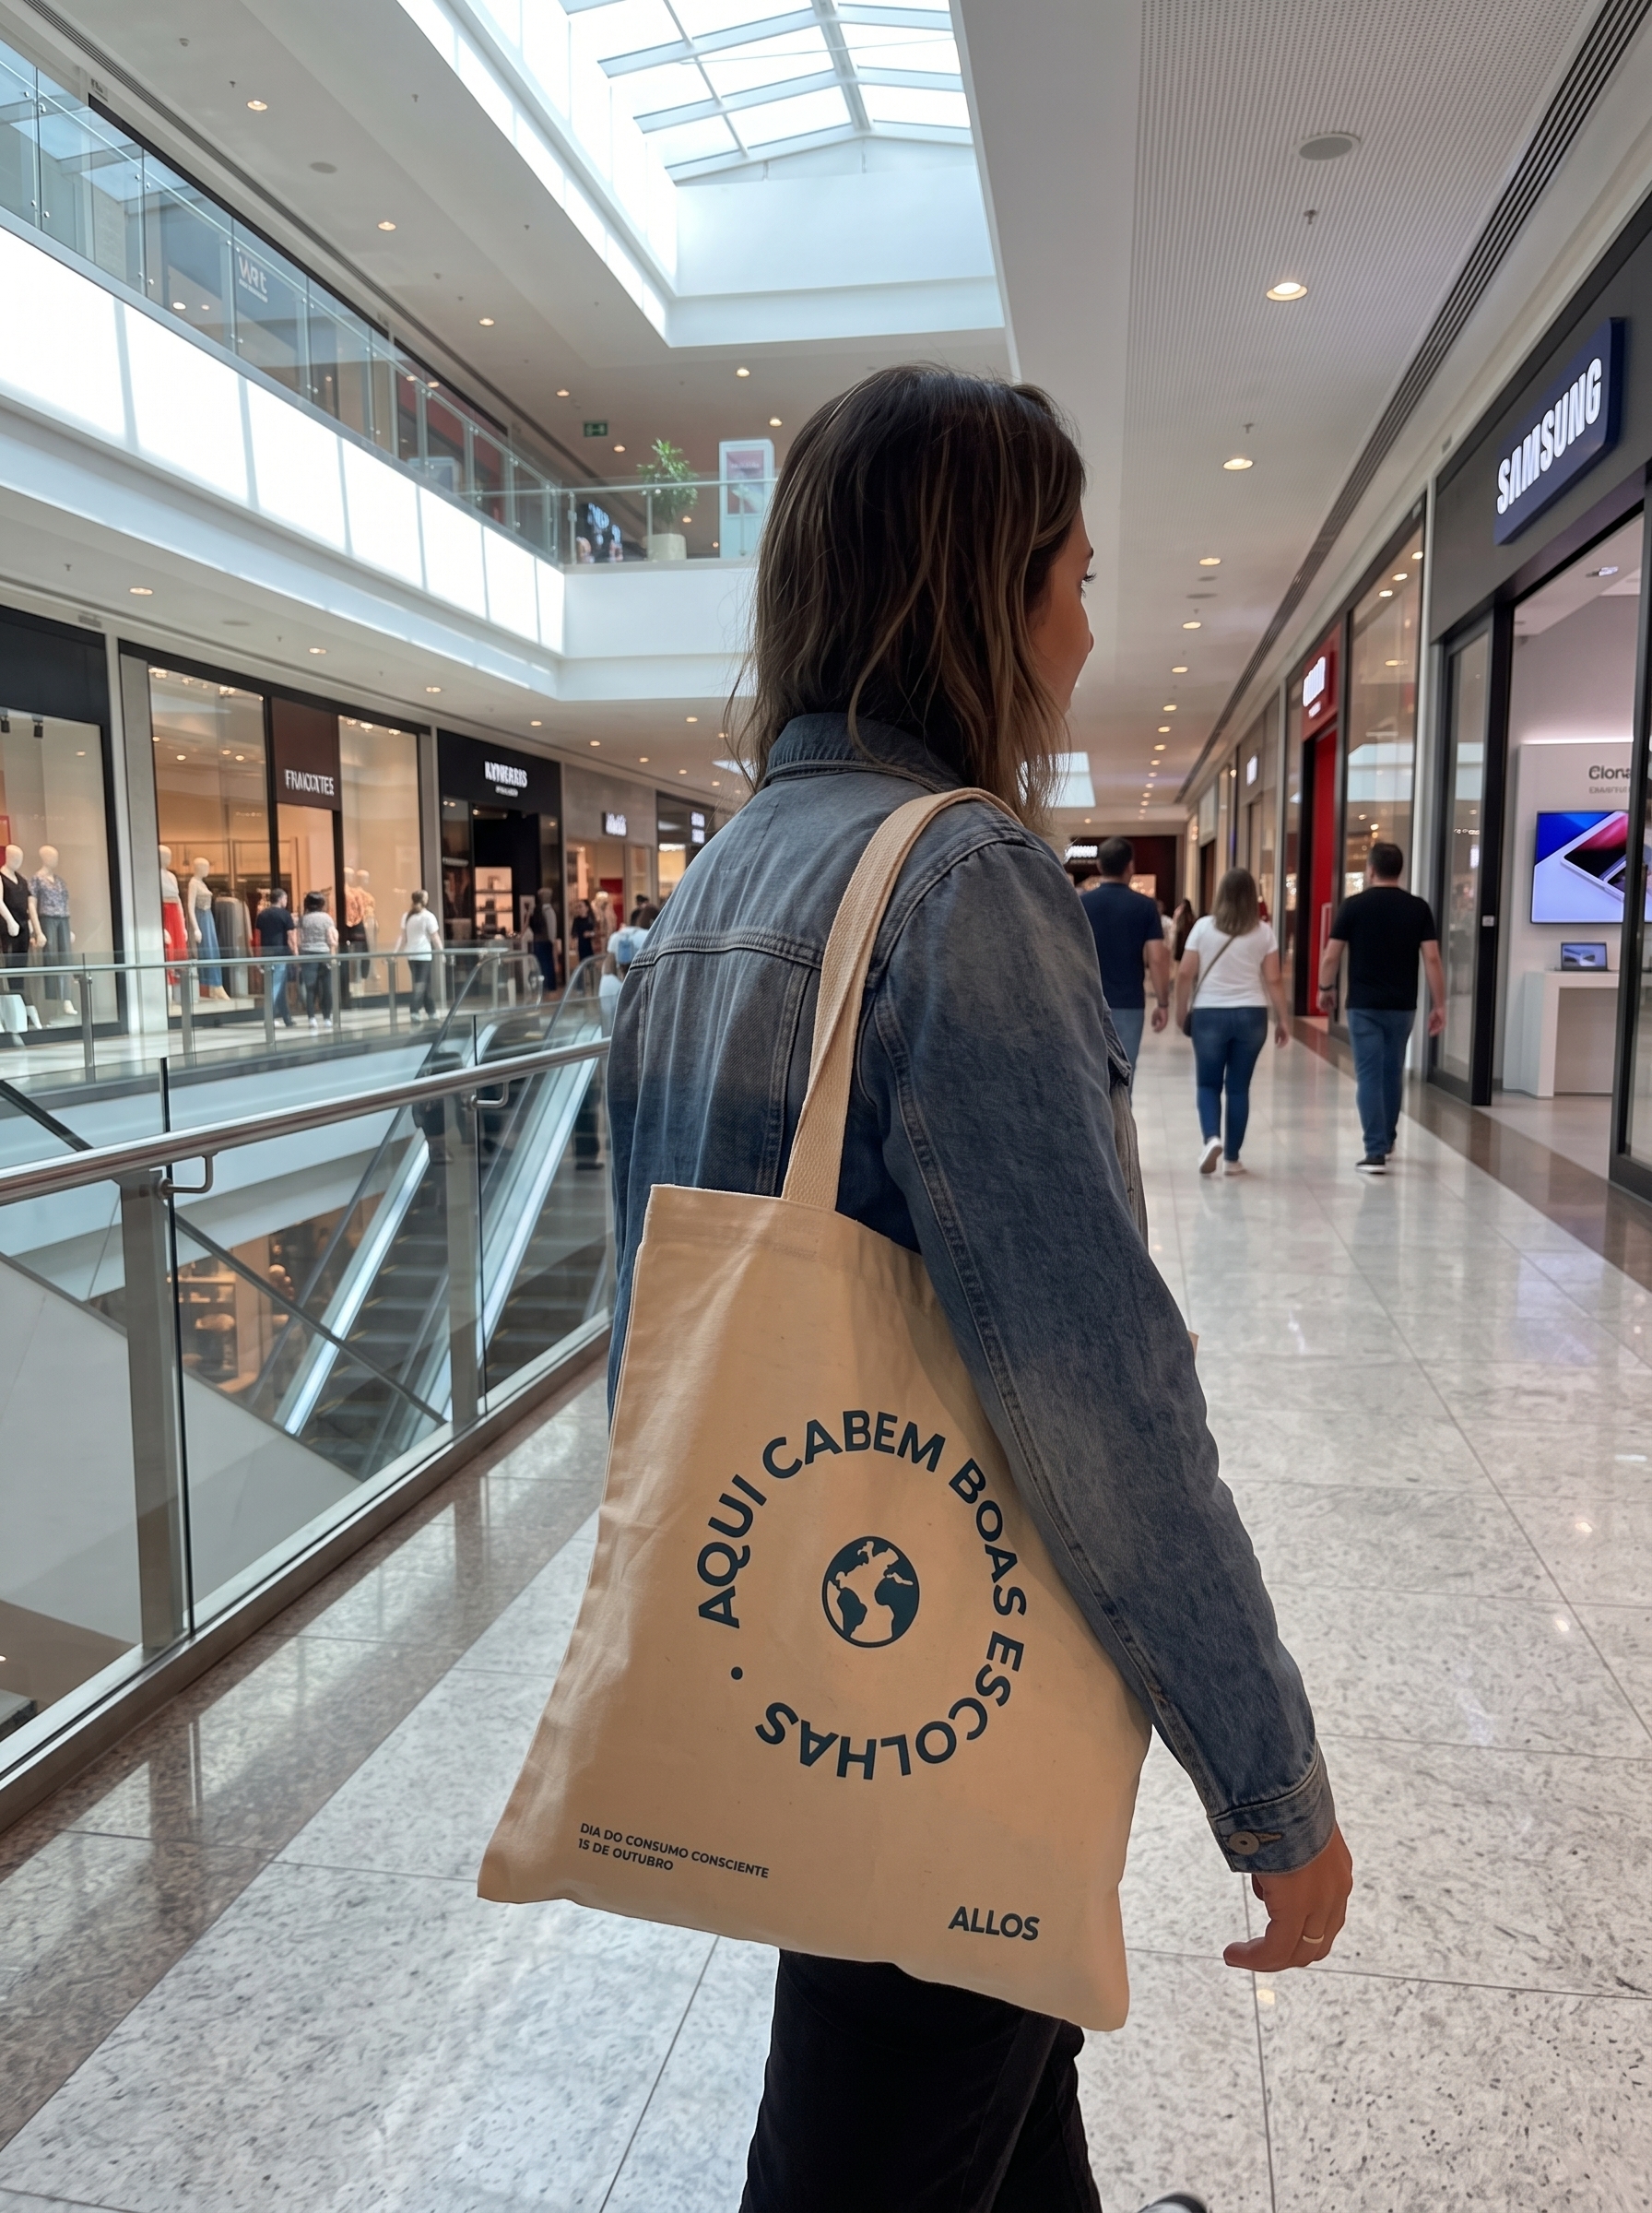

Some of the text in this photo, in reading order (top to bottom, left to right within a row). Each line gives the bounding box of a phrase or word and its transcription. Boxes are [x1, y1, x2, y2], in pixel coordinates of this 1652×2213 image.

[1497, 358, 1602, 515] SAMSUNG
[697, 1410, 1027, 1781] AQUI CABEM BOAS ESCOLHAS
[578, 1838, 674, 1871] 15 DE OUTUBRO
[580, 1823, 770, 1879] DIA DO CONSUMO CONSCIENTE
[948, 1905, 1040, 1941] ALLOS
